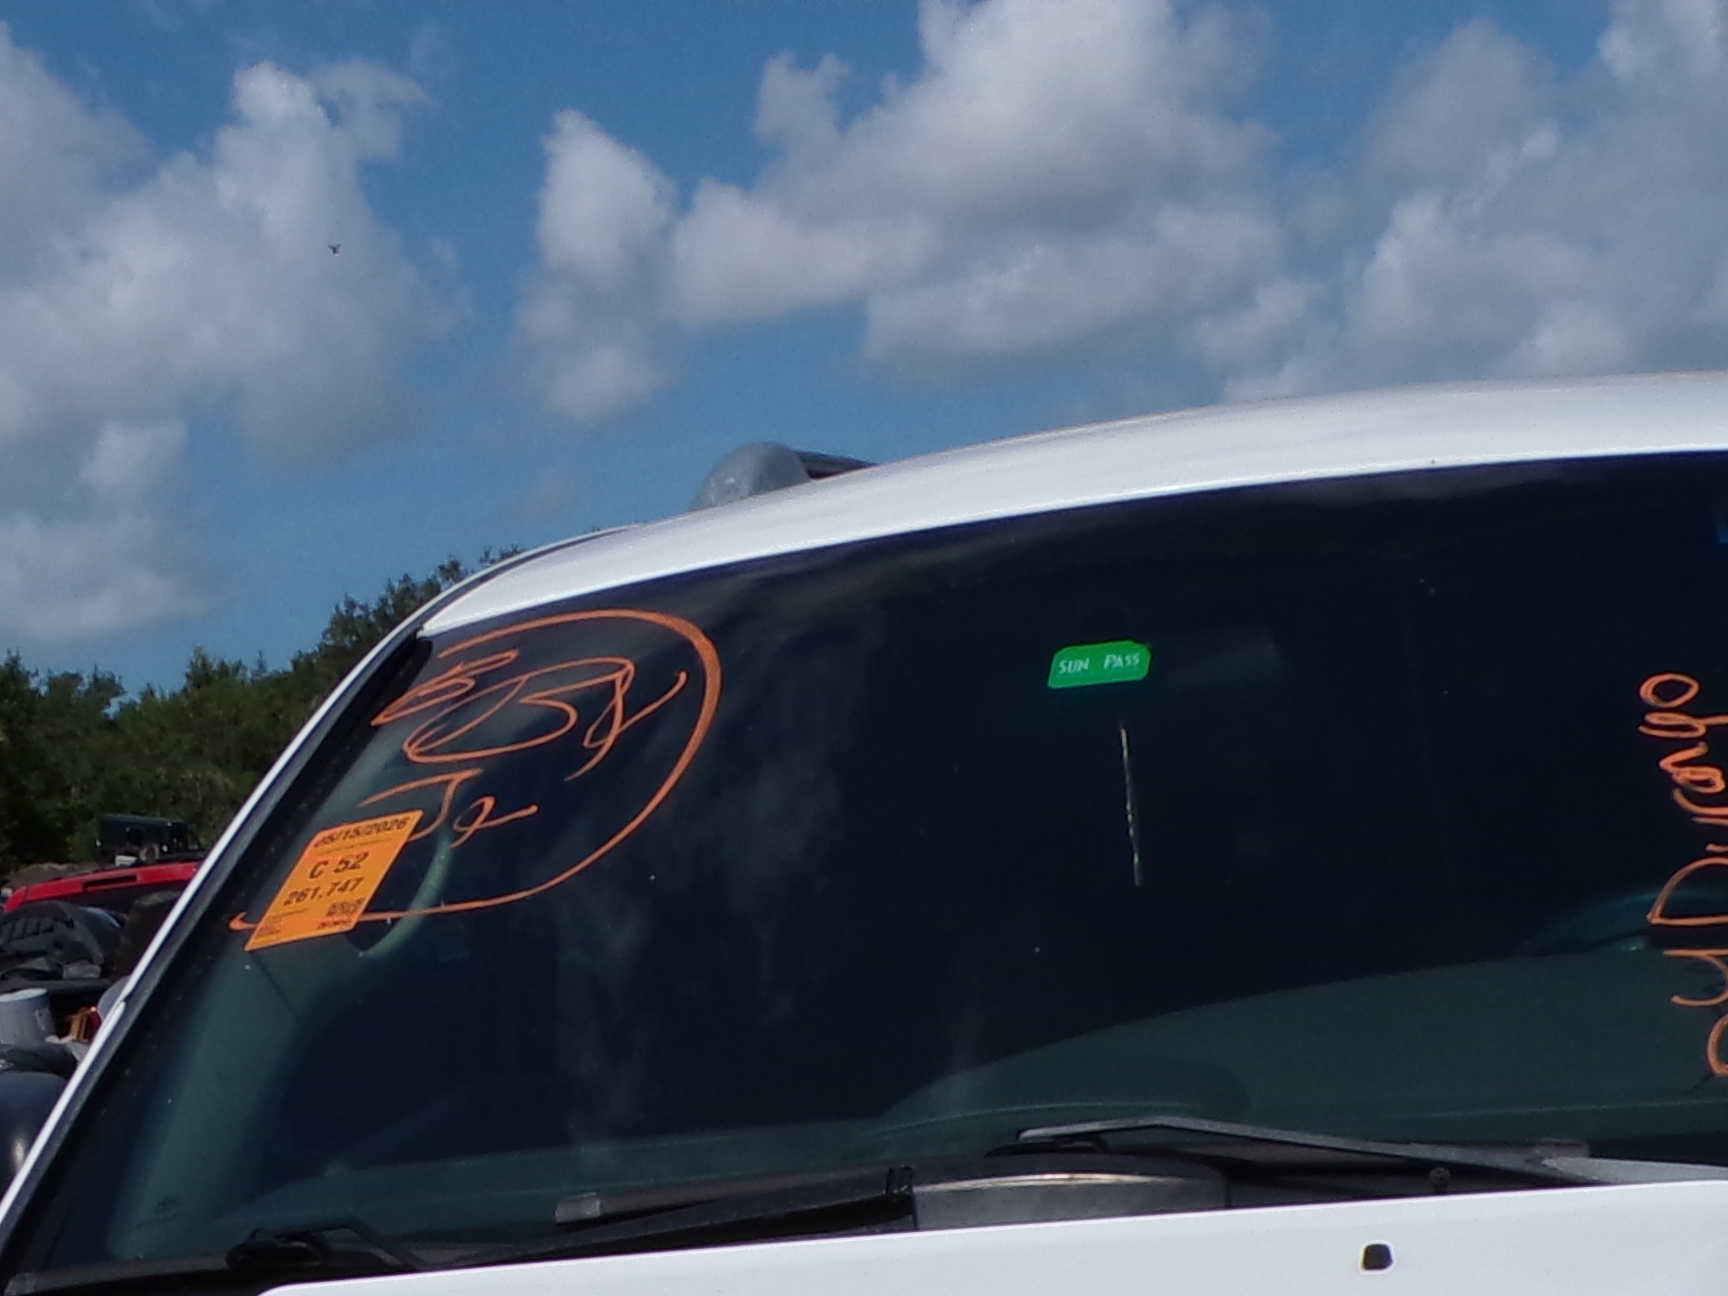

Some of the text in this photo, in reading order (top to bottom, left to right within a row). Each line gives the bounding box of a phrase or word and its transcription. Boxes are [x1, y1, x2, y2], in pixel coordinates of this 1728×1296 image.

[1059, 652, 1140, 674] SUN PASS
[309, 851, 370, 880] C 52
